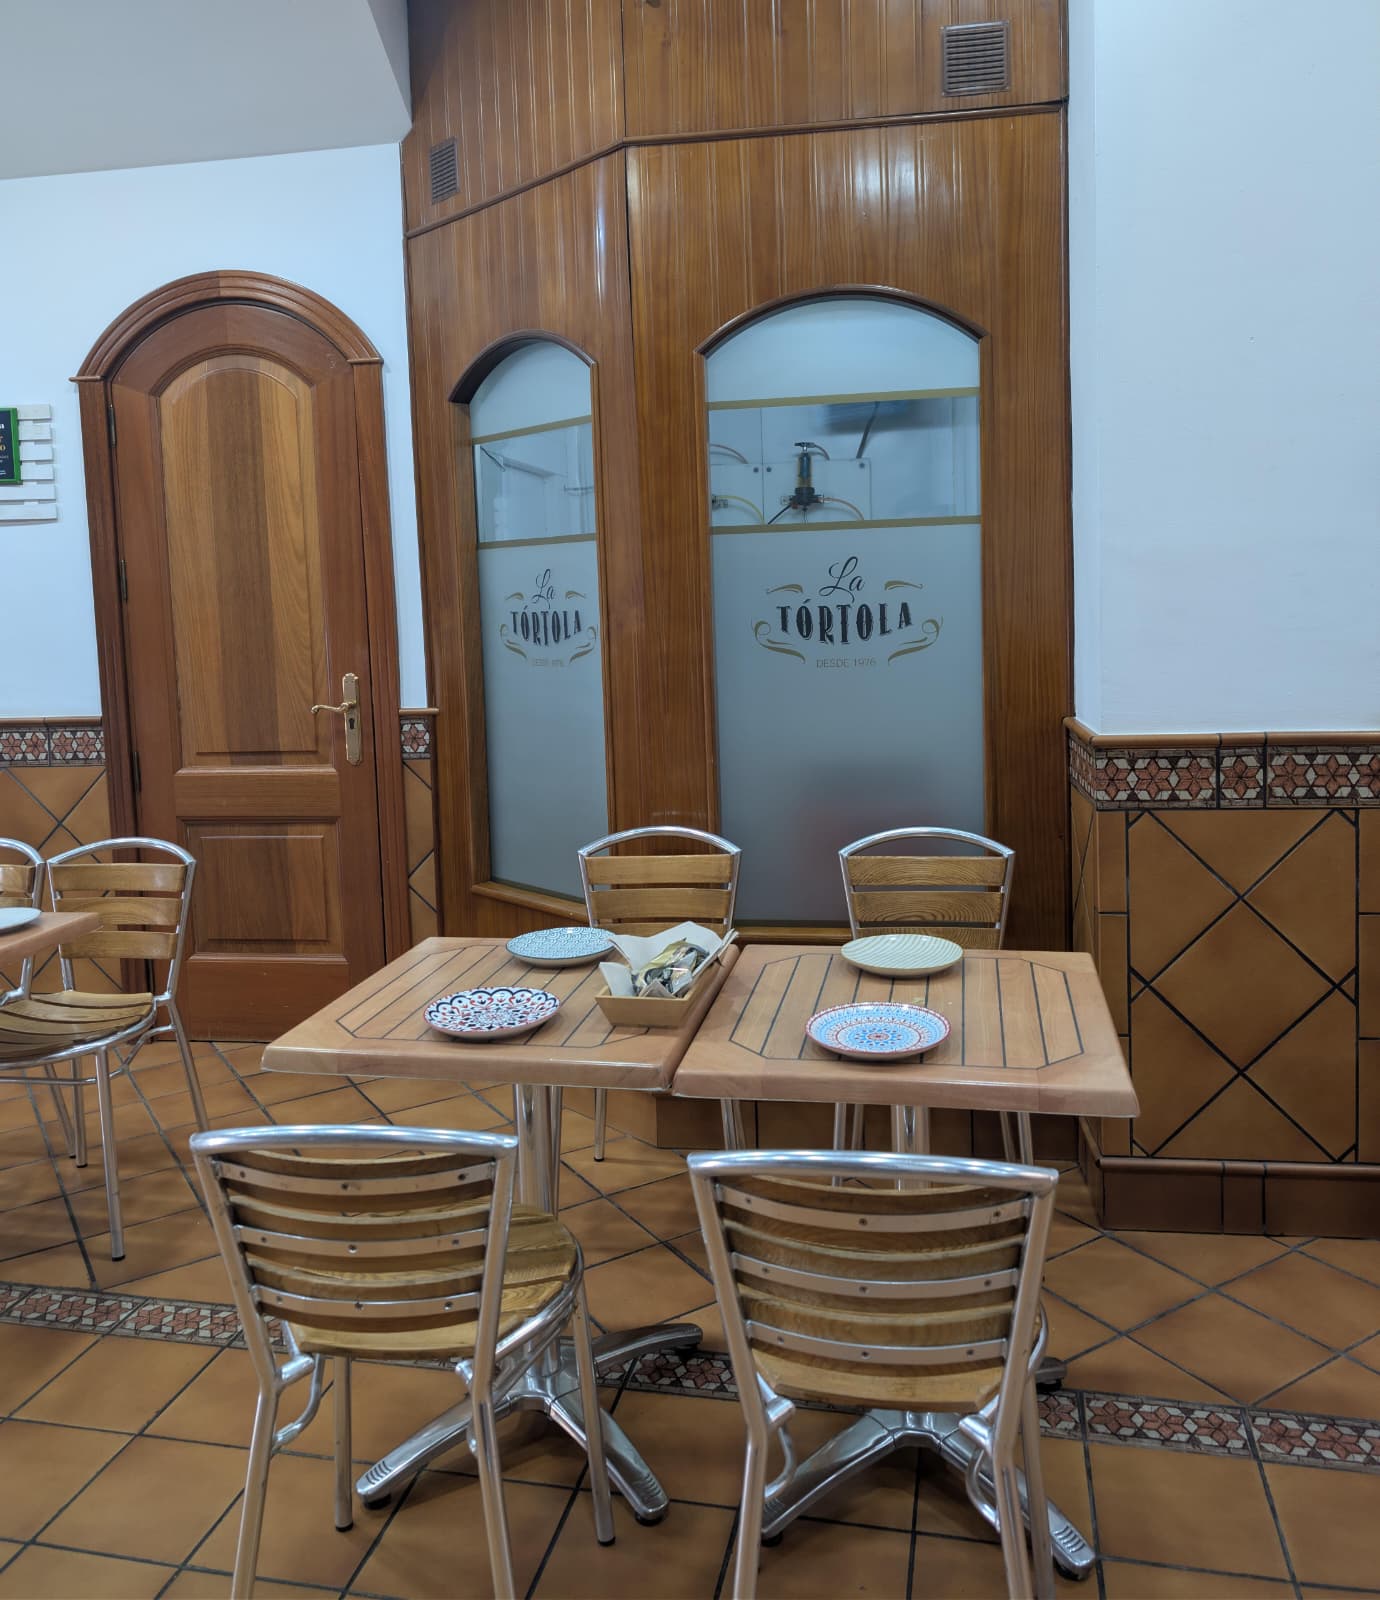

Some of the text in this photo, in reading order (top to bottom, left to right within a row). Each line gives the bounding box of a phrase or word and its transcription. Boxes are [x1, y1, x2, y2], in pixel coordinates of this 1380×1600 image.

[532, 568, 554, 609] La
[818, 556, 864, 603] La
[510, 605, 582, 646] TÓRTOLA
[776, 598, 913, 645] TÓRTOLA
[816, 658, 849, 669] DESDE
